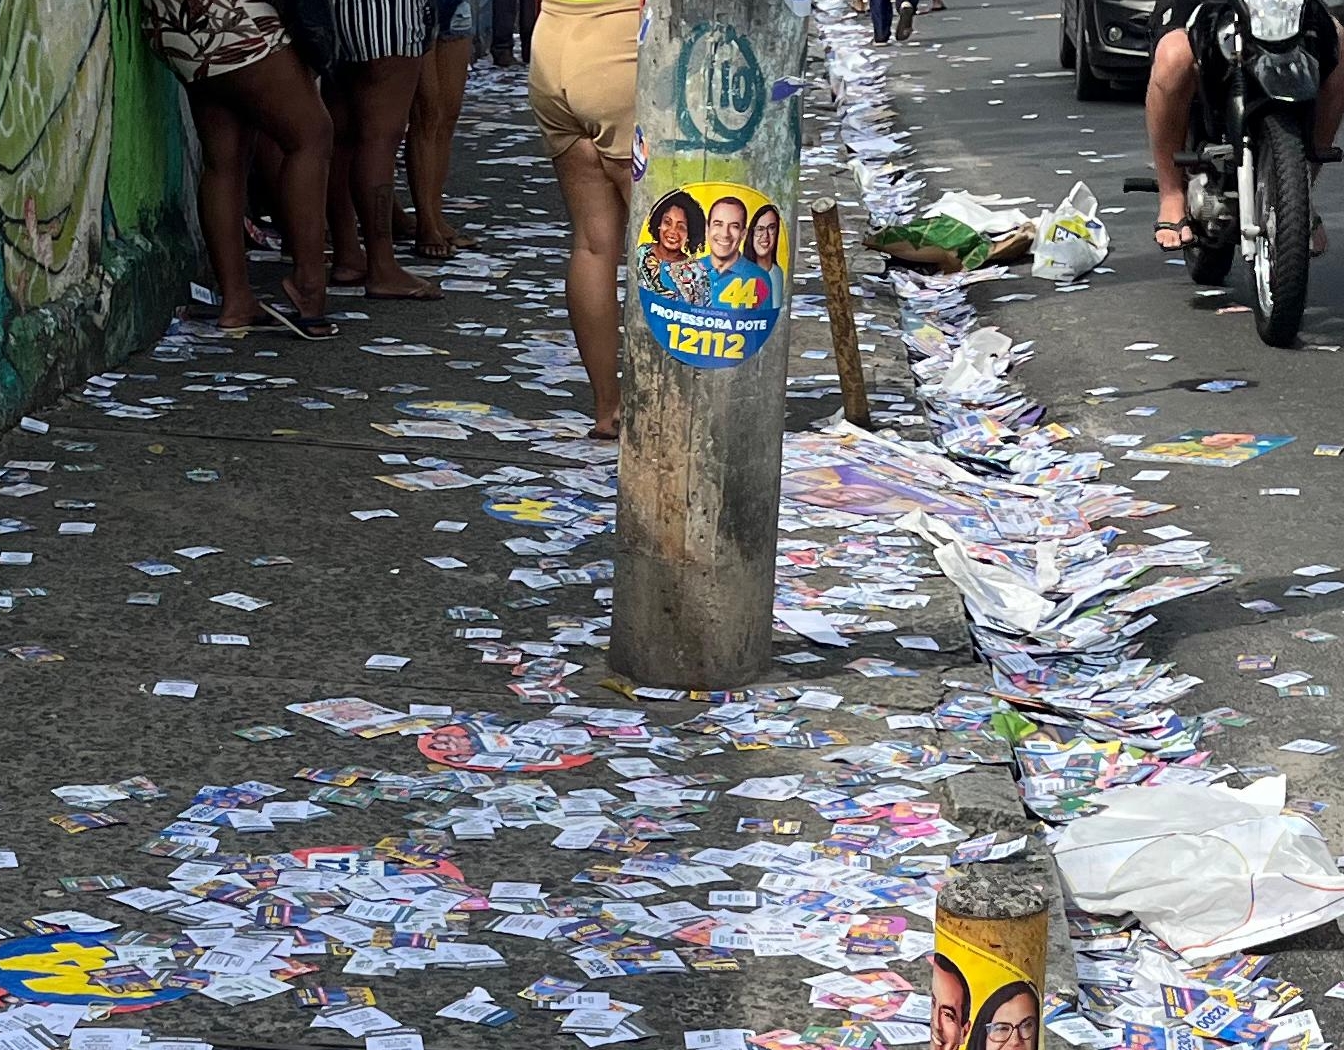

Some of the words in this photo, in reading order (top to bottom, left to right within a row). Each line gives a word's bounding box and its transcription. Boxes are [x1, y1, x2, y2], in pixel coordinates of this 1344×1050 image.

[719, 278, 758, 308] 44
[650, 302, 733, 331] PROFESSORA
[735, 316, 766, 331] DOTE
[667, 323, 745, 359] 12112
